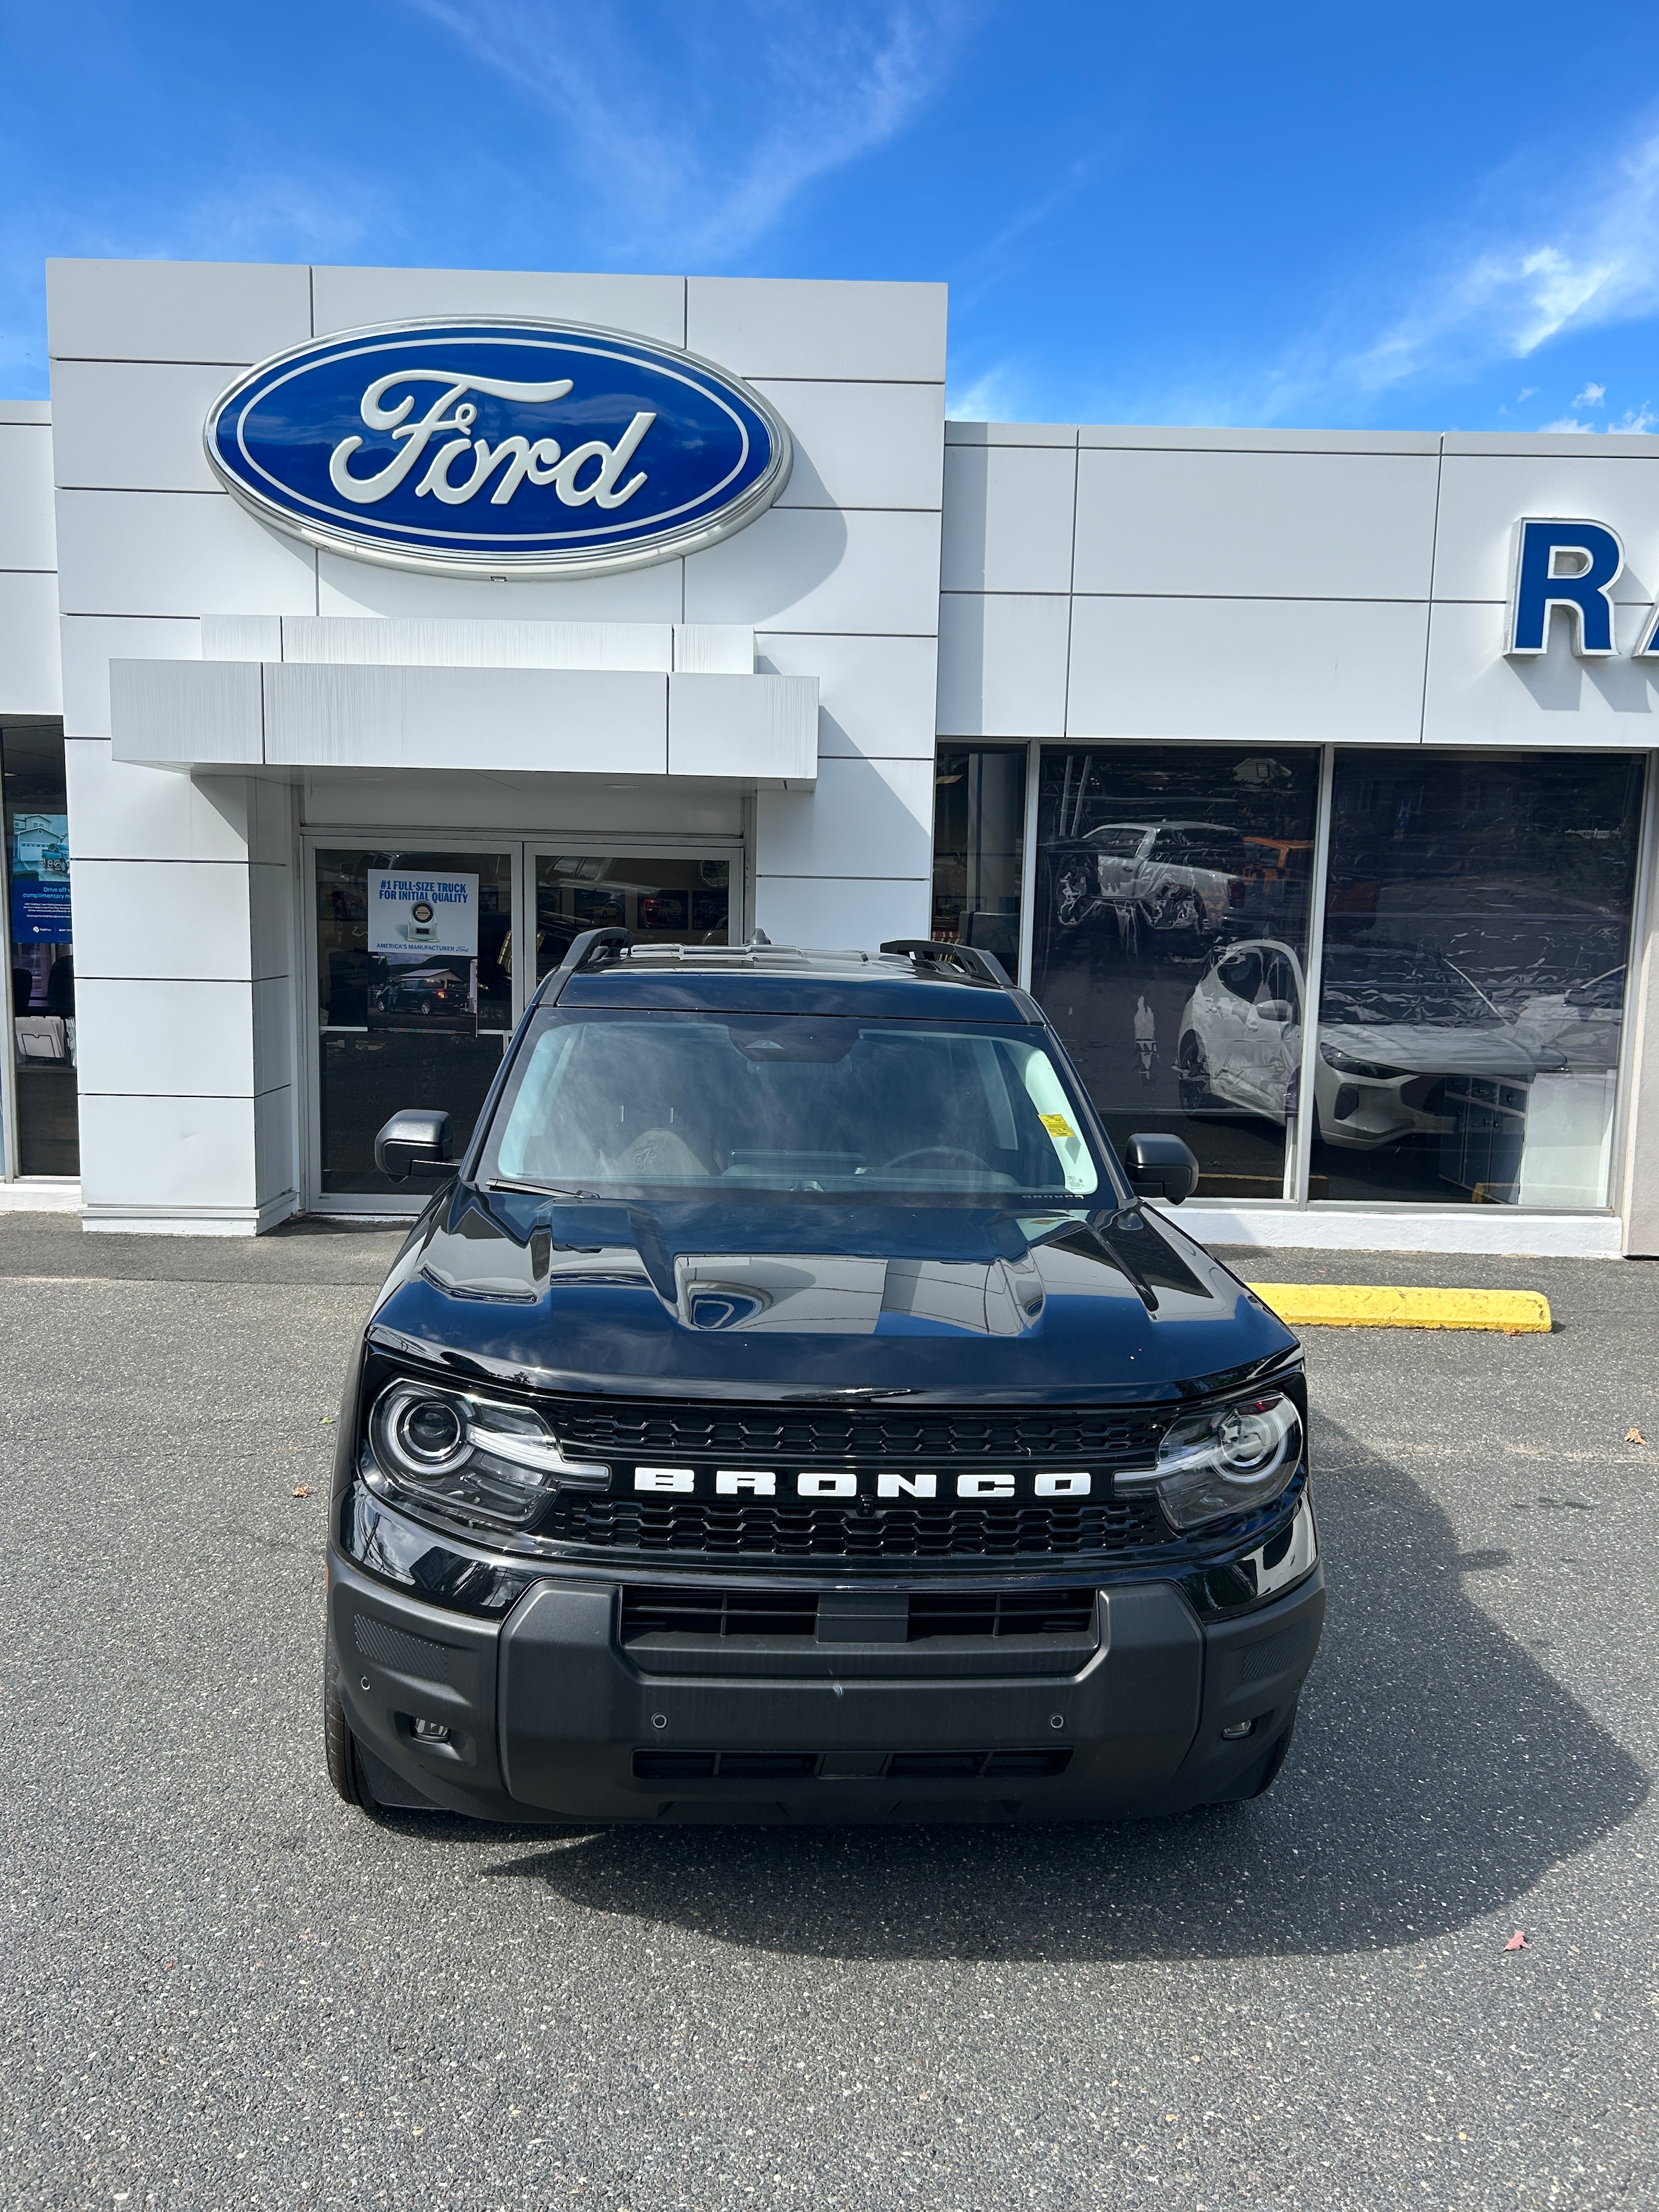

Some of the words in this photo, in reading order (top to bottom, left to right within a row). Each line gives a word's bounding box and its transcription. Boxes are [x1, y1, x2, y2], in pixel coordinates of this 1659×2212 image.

[330, 369, 657, 510] Ford
[1503, 518, 1659, 658] R
[379, 890, 396, 900] FOR
[399, 891, 429, 901] INITIAL
[431, 892, 469, 903] QUALITY
[380, 880, 391, 890] #1
[394, 881, 435, 892] FULL-SIZE
[437, 882, 467, 893] TRUCK
[634, 1466, 1092, 1498] BRONCO
